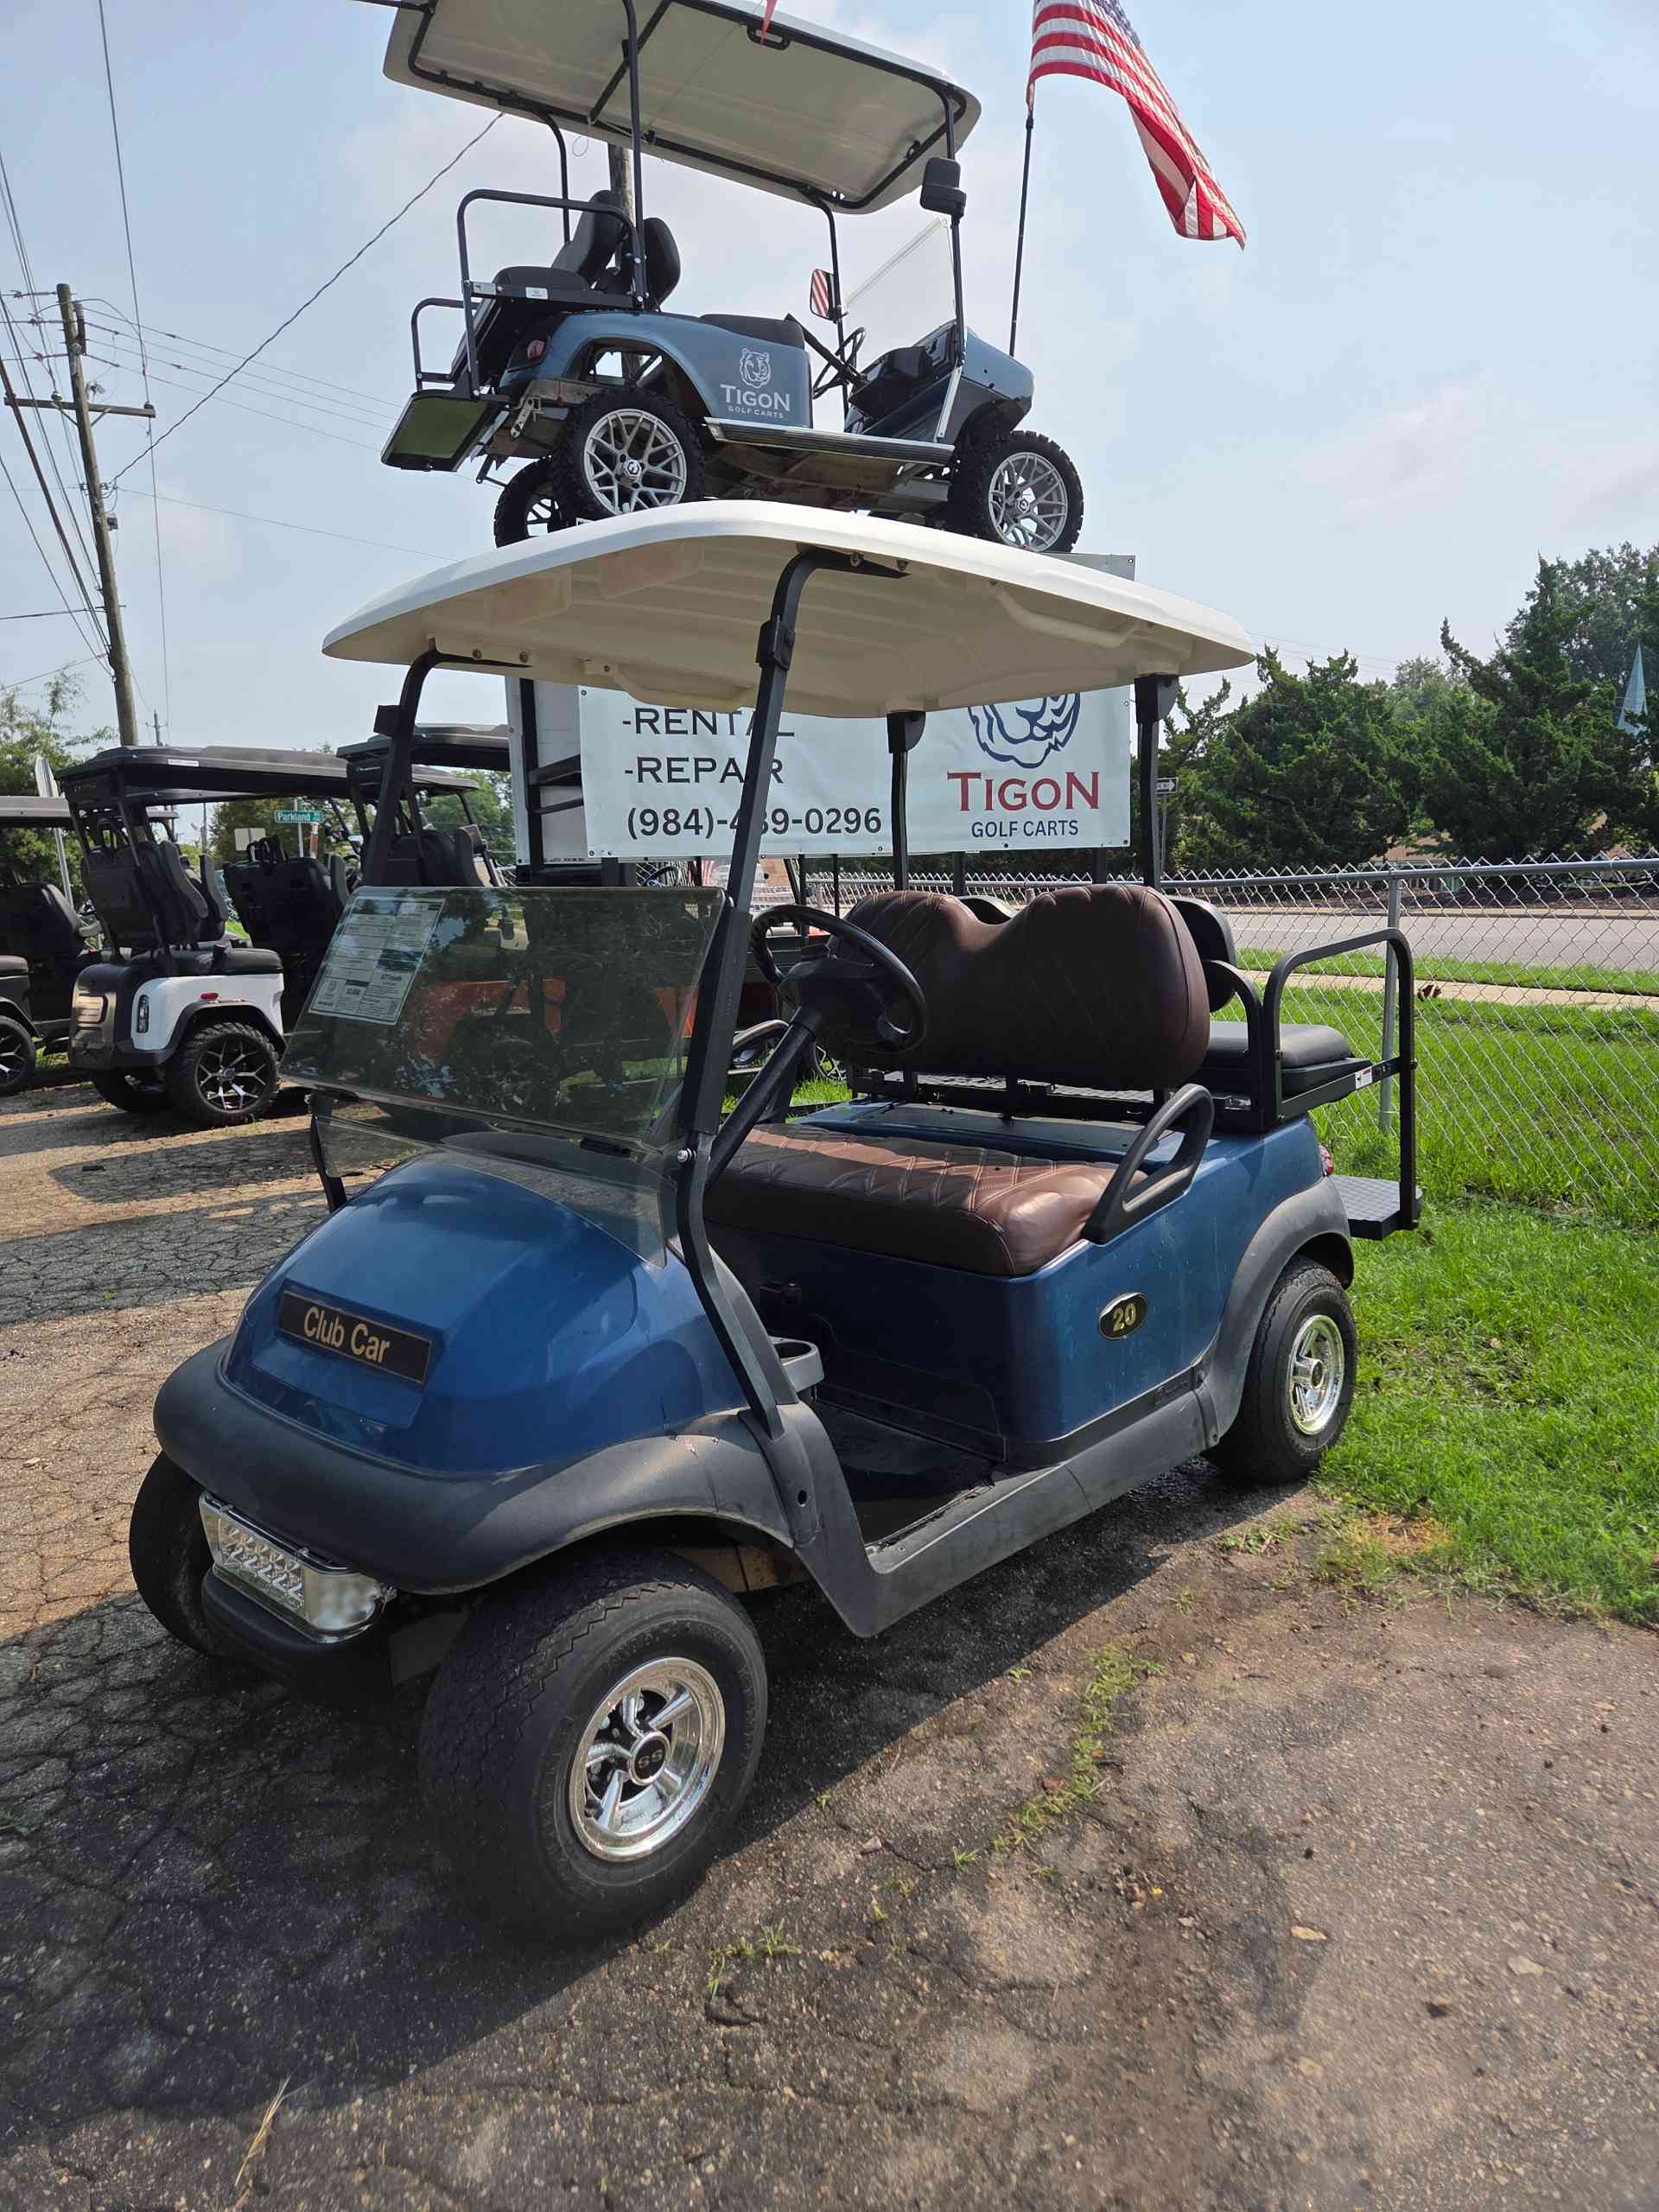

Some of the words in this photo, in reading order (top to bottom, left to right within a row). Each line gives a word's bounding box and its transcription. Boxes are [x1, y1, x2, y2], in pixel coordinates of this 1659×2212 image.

[721, 384, 791, 411] TIGON
[728, 406, 753, 416] GOLF
[754, 409, 784, 419] CARTS
[622, 708, 795, 736] -RENT
[624, 756, 784, 784] -REPAR
[947, 771, 1100, 811] TIGON
[277, 812, 311, 822] Parkland
[971, 821, 1019, 838] GOLF
[1023, 819, 1078, 837] CARTS
[1112, 1302, 1137, 1332] 20
[303, 1306, 346, 1347] Club
[350, 1323, 391, 1363] Car
